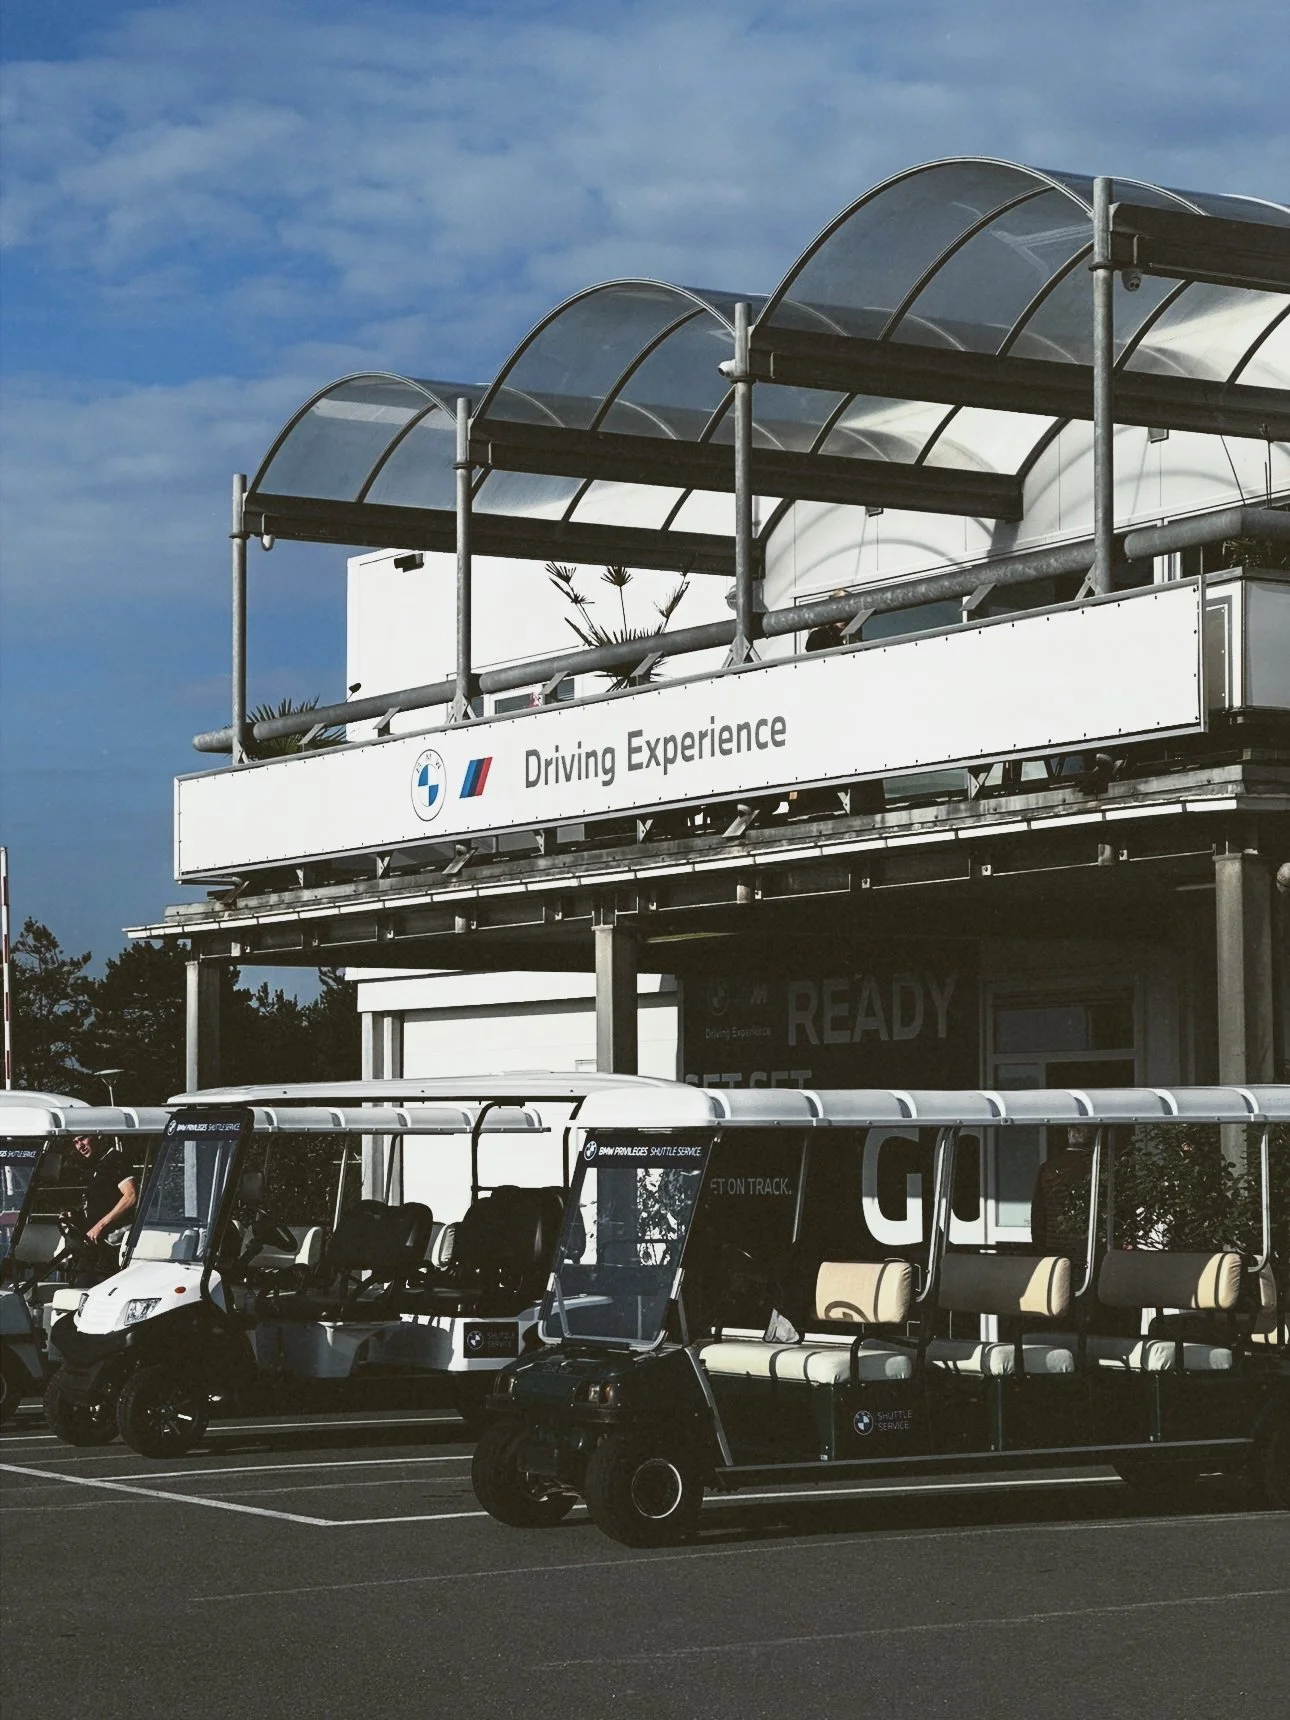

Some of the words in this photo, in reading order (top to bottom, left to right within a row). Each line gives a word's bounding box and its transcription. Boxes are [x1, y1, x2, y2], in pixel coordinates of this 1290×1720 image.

[525, 741, 616, 788] Driving
[627, 715, 787, 775] Experience
[787, 970, 959, 1047] READY
[705, 1028, 731, 1042] Driving
[732, 1026, 772, 1040] Experience
[599, 1147, 615, 1156] BMW
[615, 1147, 648, 1156] PRIVILEGES
[650, 1147, 677, 1156] SHUTTLE
[727, 1178, 745, 1195] ON
[748, 1177, 792, 1195] TRACK.
[877, 1410, 912, 1421] SHUTTLE
[877, 1421, 909, 1431] SERVICE
